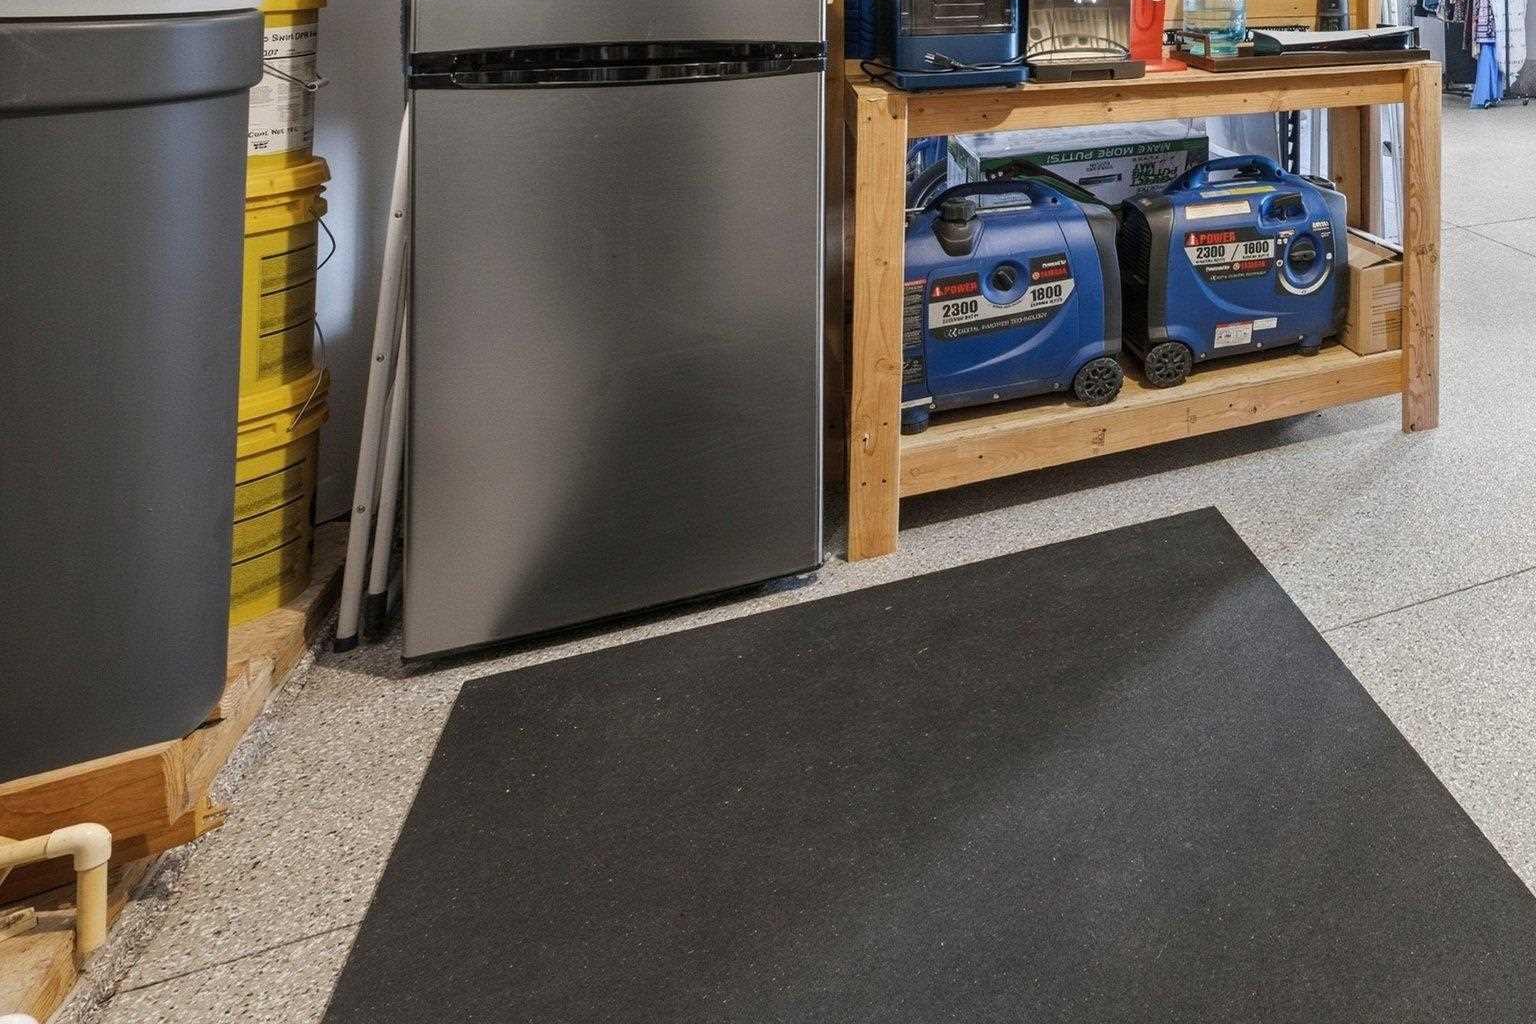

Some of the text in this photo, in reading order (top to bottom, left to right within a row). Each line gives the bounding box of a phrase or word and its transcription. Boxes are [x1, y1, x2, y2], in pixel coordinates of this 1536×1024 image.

[1046, 150, 1093, 164] PUTTS!
[1099, 145, 1134, 158] MORE
[1030, 284, 1063, 302] 1800
[942, 299, 979, 318] 2300
